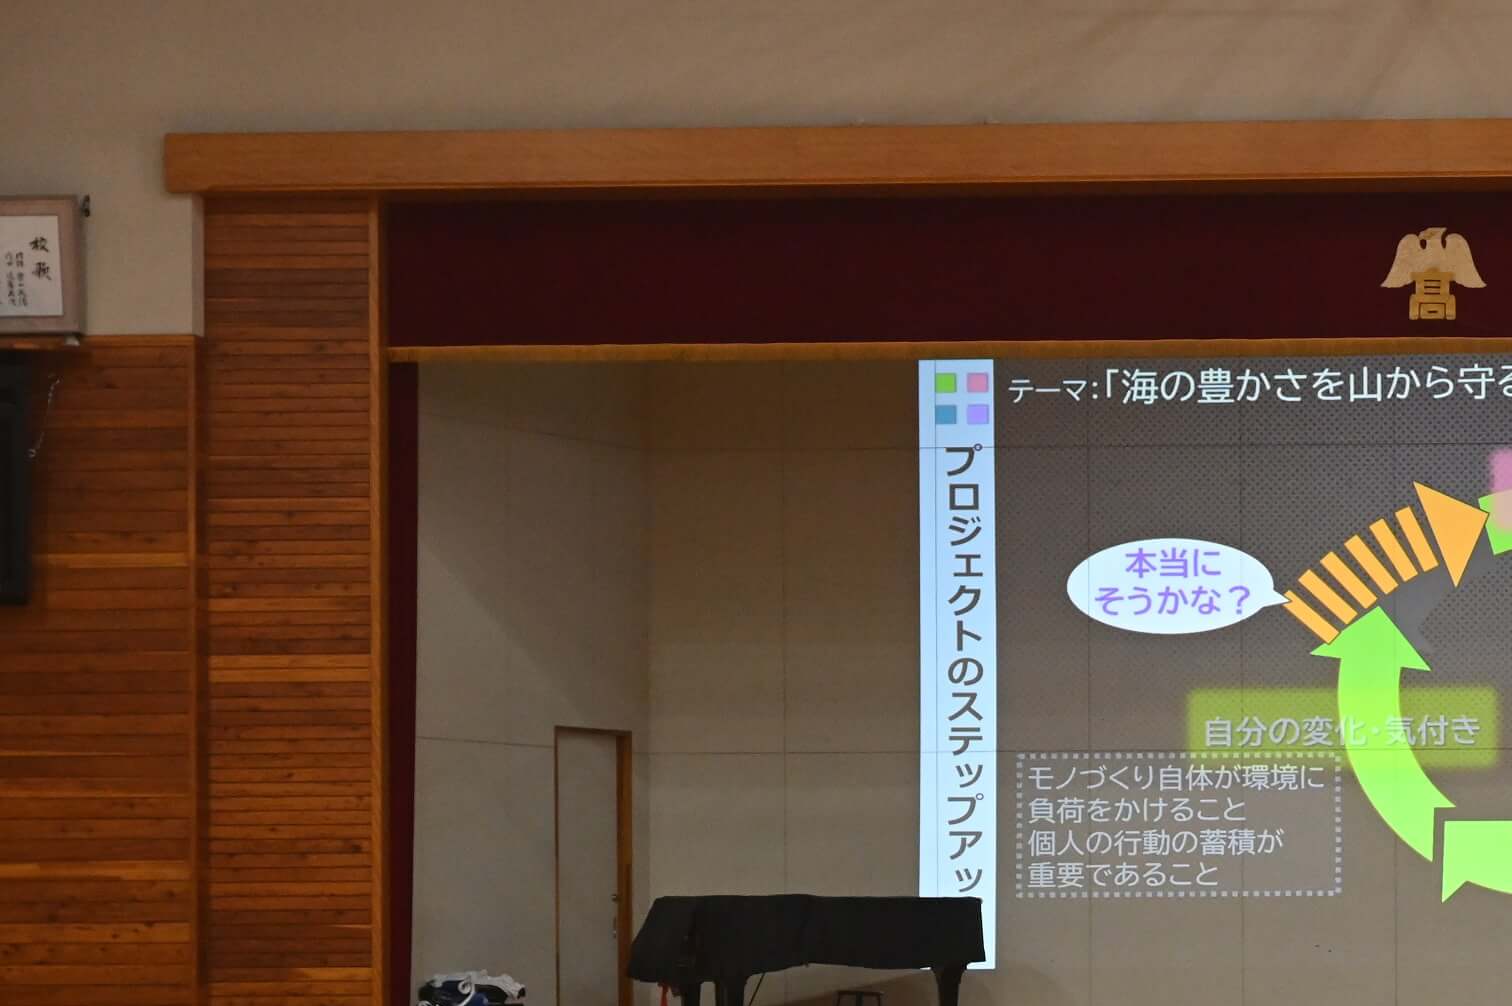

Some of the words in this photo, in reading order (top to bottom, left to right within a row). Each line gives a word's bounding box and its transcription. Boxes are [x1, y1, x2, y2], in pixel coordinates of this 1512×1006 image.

[1125, 547, 1222, 579] 本当に
[1094, 585, 1251, 616] そうかな？
[945, 443, 984, 893] プロジェクトのステップアッ
[1204, 714, 1481, 747] 自分の変化・気付き
[1027, 764, 1326, 791] モノづくり自体が環境に
[1027, 797, 1248, 825] 負荷をかけること
[1027, 828, 1286, 857] 個人の行動の蓄積が
[1027, 861, 1219, 889] 重要であること
